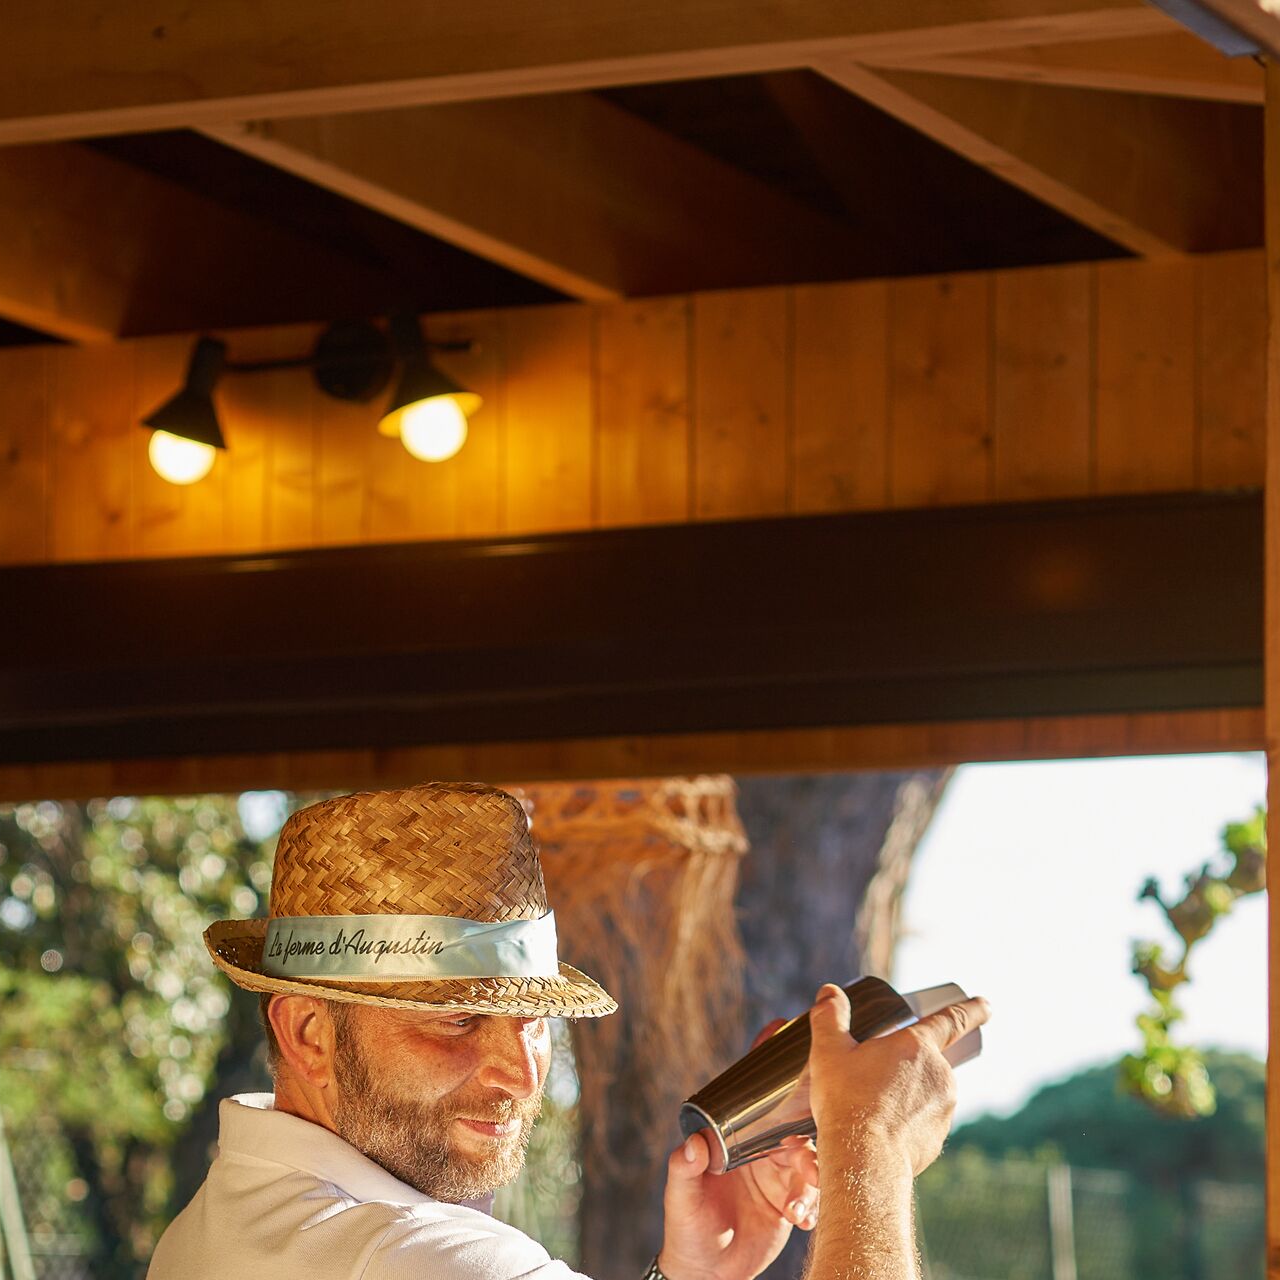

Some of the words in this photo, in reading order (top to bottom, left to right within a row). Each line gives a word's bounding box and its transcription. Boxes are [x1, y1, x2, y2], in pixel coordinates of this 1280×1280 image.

[268, 931, 282, 957] La
[282, 930, 326, 965] ferme
[329, 928, 446, 964] d'Augustin
